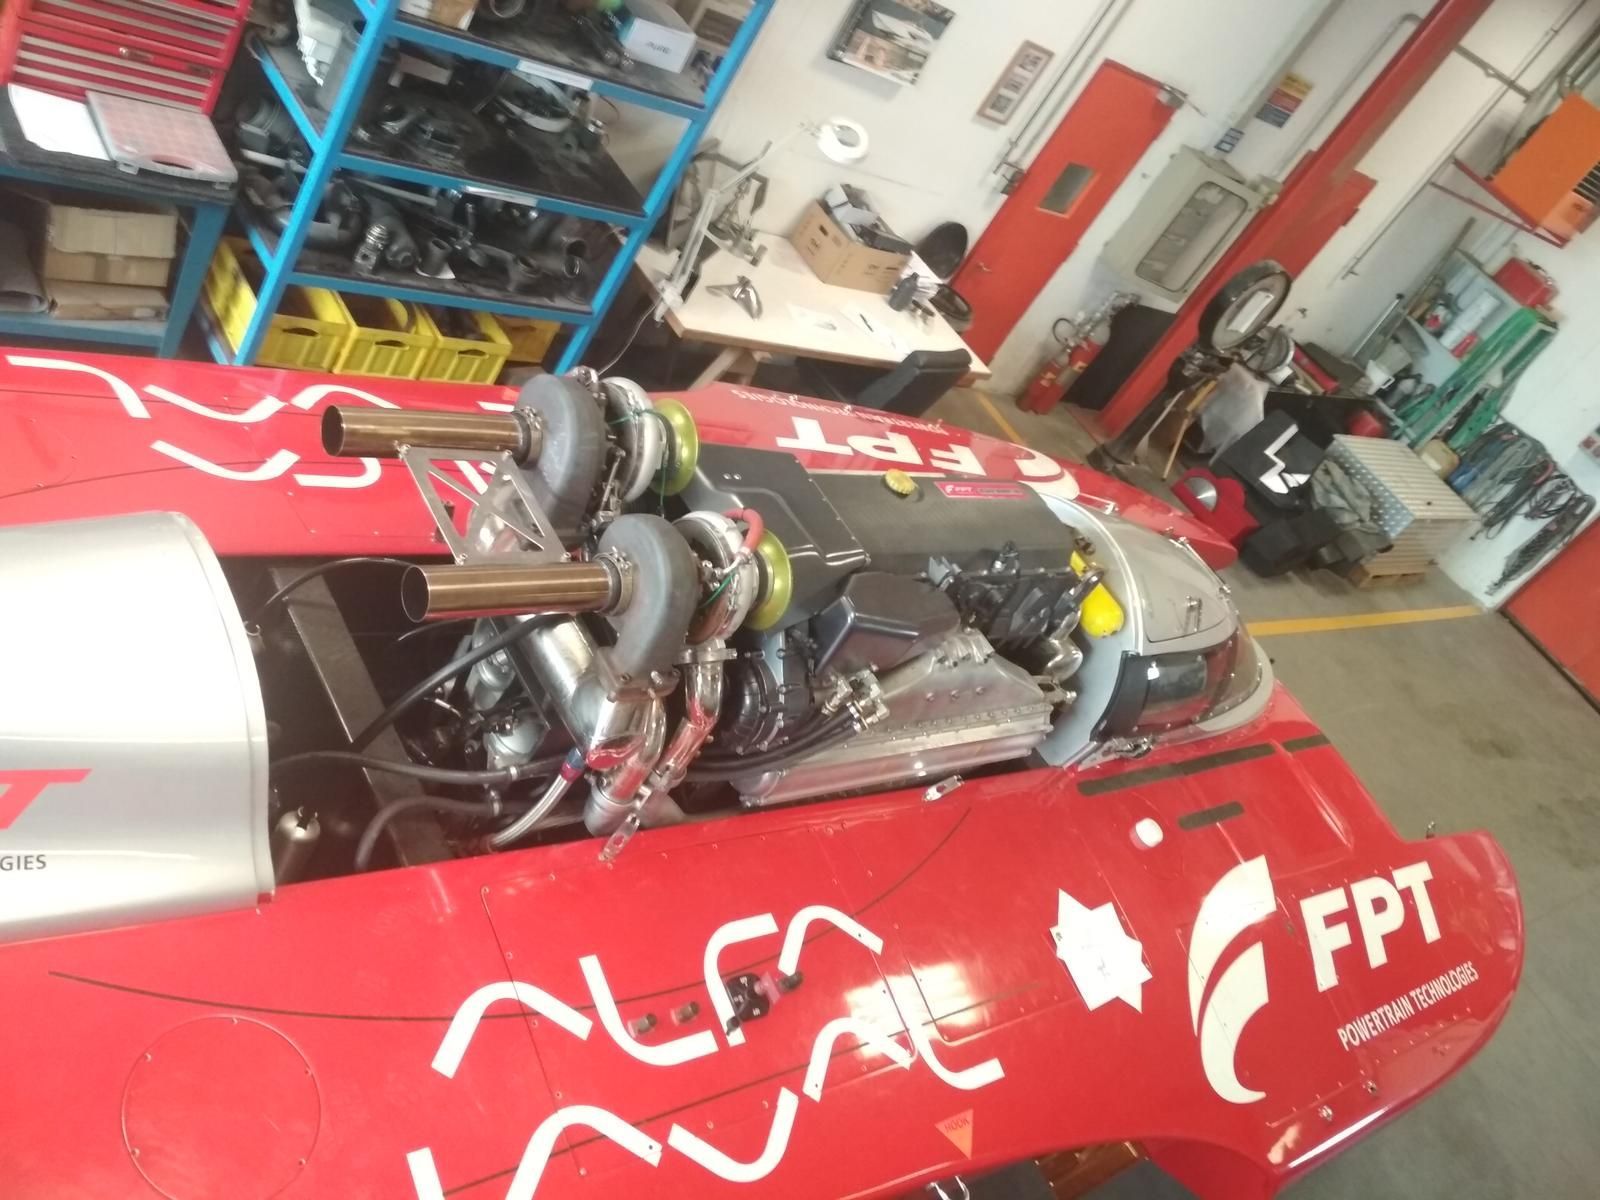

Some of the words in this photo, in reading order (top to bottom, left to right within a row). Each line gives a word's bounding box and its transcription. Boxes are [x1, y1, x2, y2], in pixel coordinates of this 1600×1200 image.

[776, 416, 987, 477] FPT
[1299, 860, 1442, 993] FPT
[1336, 998, 1415, 1052] POWERTRAIN
[1409, 960, 1480, 1011] TECHNOLOGIES
